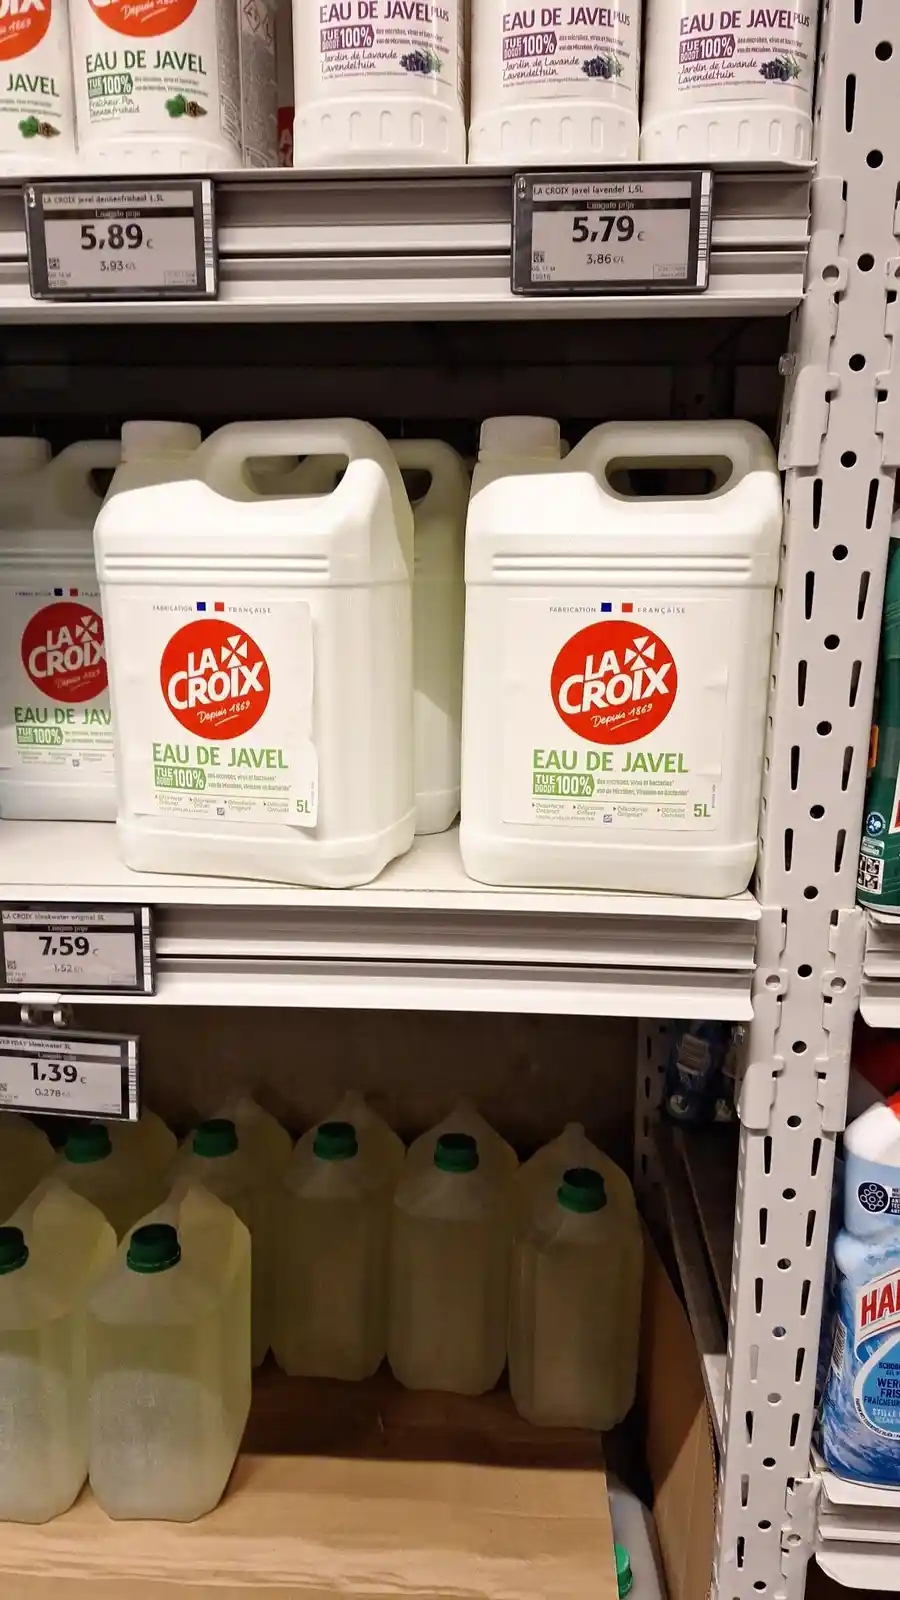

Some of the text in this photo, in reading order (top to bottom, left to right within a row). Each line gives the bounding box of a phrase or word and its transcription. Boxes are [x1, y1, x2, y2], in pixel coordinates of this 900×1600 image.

[320, 0, 450, 23] EAU DE JAVEL PLUS
[502, 7, 631, 32] EAU DE JAVEL PLUS
[680, 9, 810, 36] EAU DE JAVEL PLUS
[323, 30, 340, 40] TUE
[340, 26, 372, 48] 100%
[505, 39, 522, 48] TUE
[522, 34, 554, 56] 100%
[681, 42, 700, 51] TUE
[700, 36, 732, 59] 100%
[86, 49, 208, 76] EAU DE JAVEL
[321, 48, 398, 63] Jardin de Lavande
[503, 56, 580, 72] Jardin de Lavande
[321, 62, 377, 73] Lavendeltuin
[503, 67, 558, 81] Lavendeltuin
[678, 58, 757, 75] Jardin de Lavande
[6, 73, 60, 97] JAVEL
[102, 75, 131, 94] 100%
[678, 70, 735, 85] Lavendeltuin
[54, 194, 76, 204] CROIX
[533, 186, 544, 195] LA
[545, 185, 569, 195] CROIX
[571, 186, 590, 197] javel
[592, 185, 625, 194] lavendel
[80, 223, 143, 251] 5,89
[572, 215, 646, 243] 5,79 €
[99, 260, 124, 272] 3,93
[586, 253, 612, 265] 3,86
[228, 606, 272, 615] FRANÇAISE
[637, 606, 685, 615] FRANÇAISE
[46, 625, 74, 651] LA
[28, 640, 107, 679] CROIX
[188, 648, 219, 678] LA
[584, 649, 621, 681] LA
[167, 661, 265, 711] CROIX
[558, 662, 673, 715] CROIX
[14, 707, 48, 724] EAU
[54, 708, 75, 724] DE
[197, 700, 252, 724] Depuis 1869
[590, 703, 653, 728] Depuis 1869
[33, 728, 61, 744] 100%
[152, 743, 289, 769] EAU DE JAVEL
[533, 749, 689, 773] EAU DE JAVEL
[157, 767, 205, 789] TUE 100%
[535, 774, 592, 795] TUE 100%
[296, 799, 310, 814] 5L
[693, 803, 711, 818] 5L
[38, 936, 90, 956] 7,59
[53, 963, 73, 973] 1,52
[30, 1062, 78, 1083] 1,39
[34, 1087, 61, 1097] 0,278
[876, 1378, 900, 1389] WER
[881, 1388, 900, 1399] FRIS
